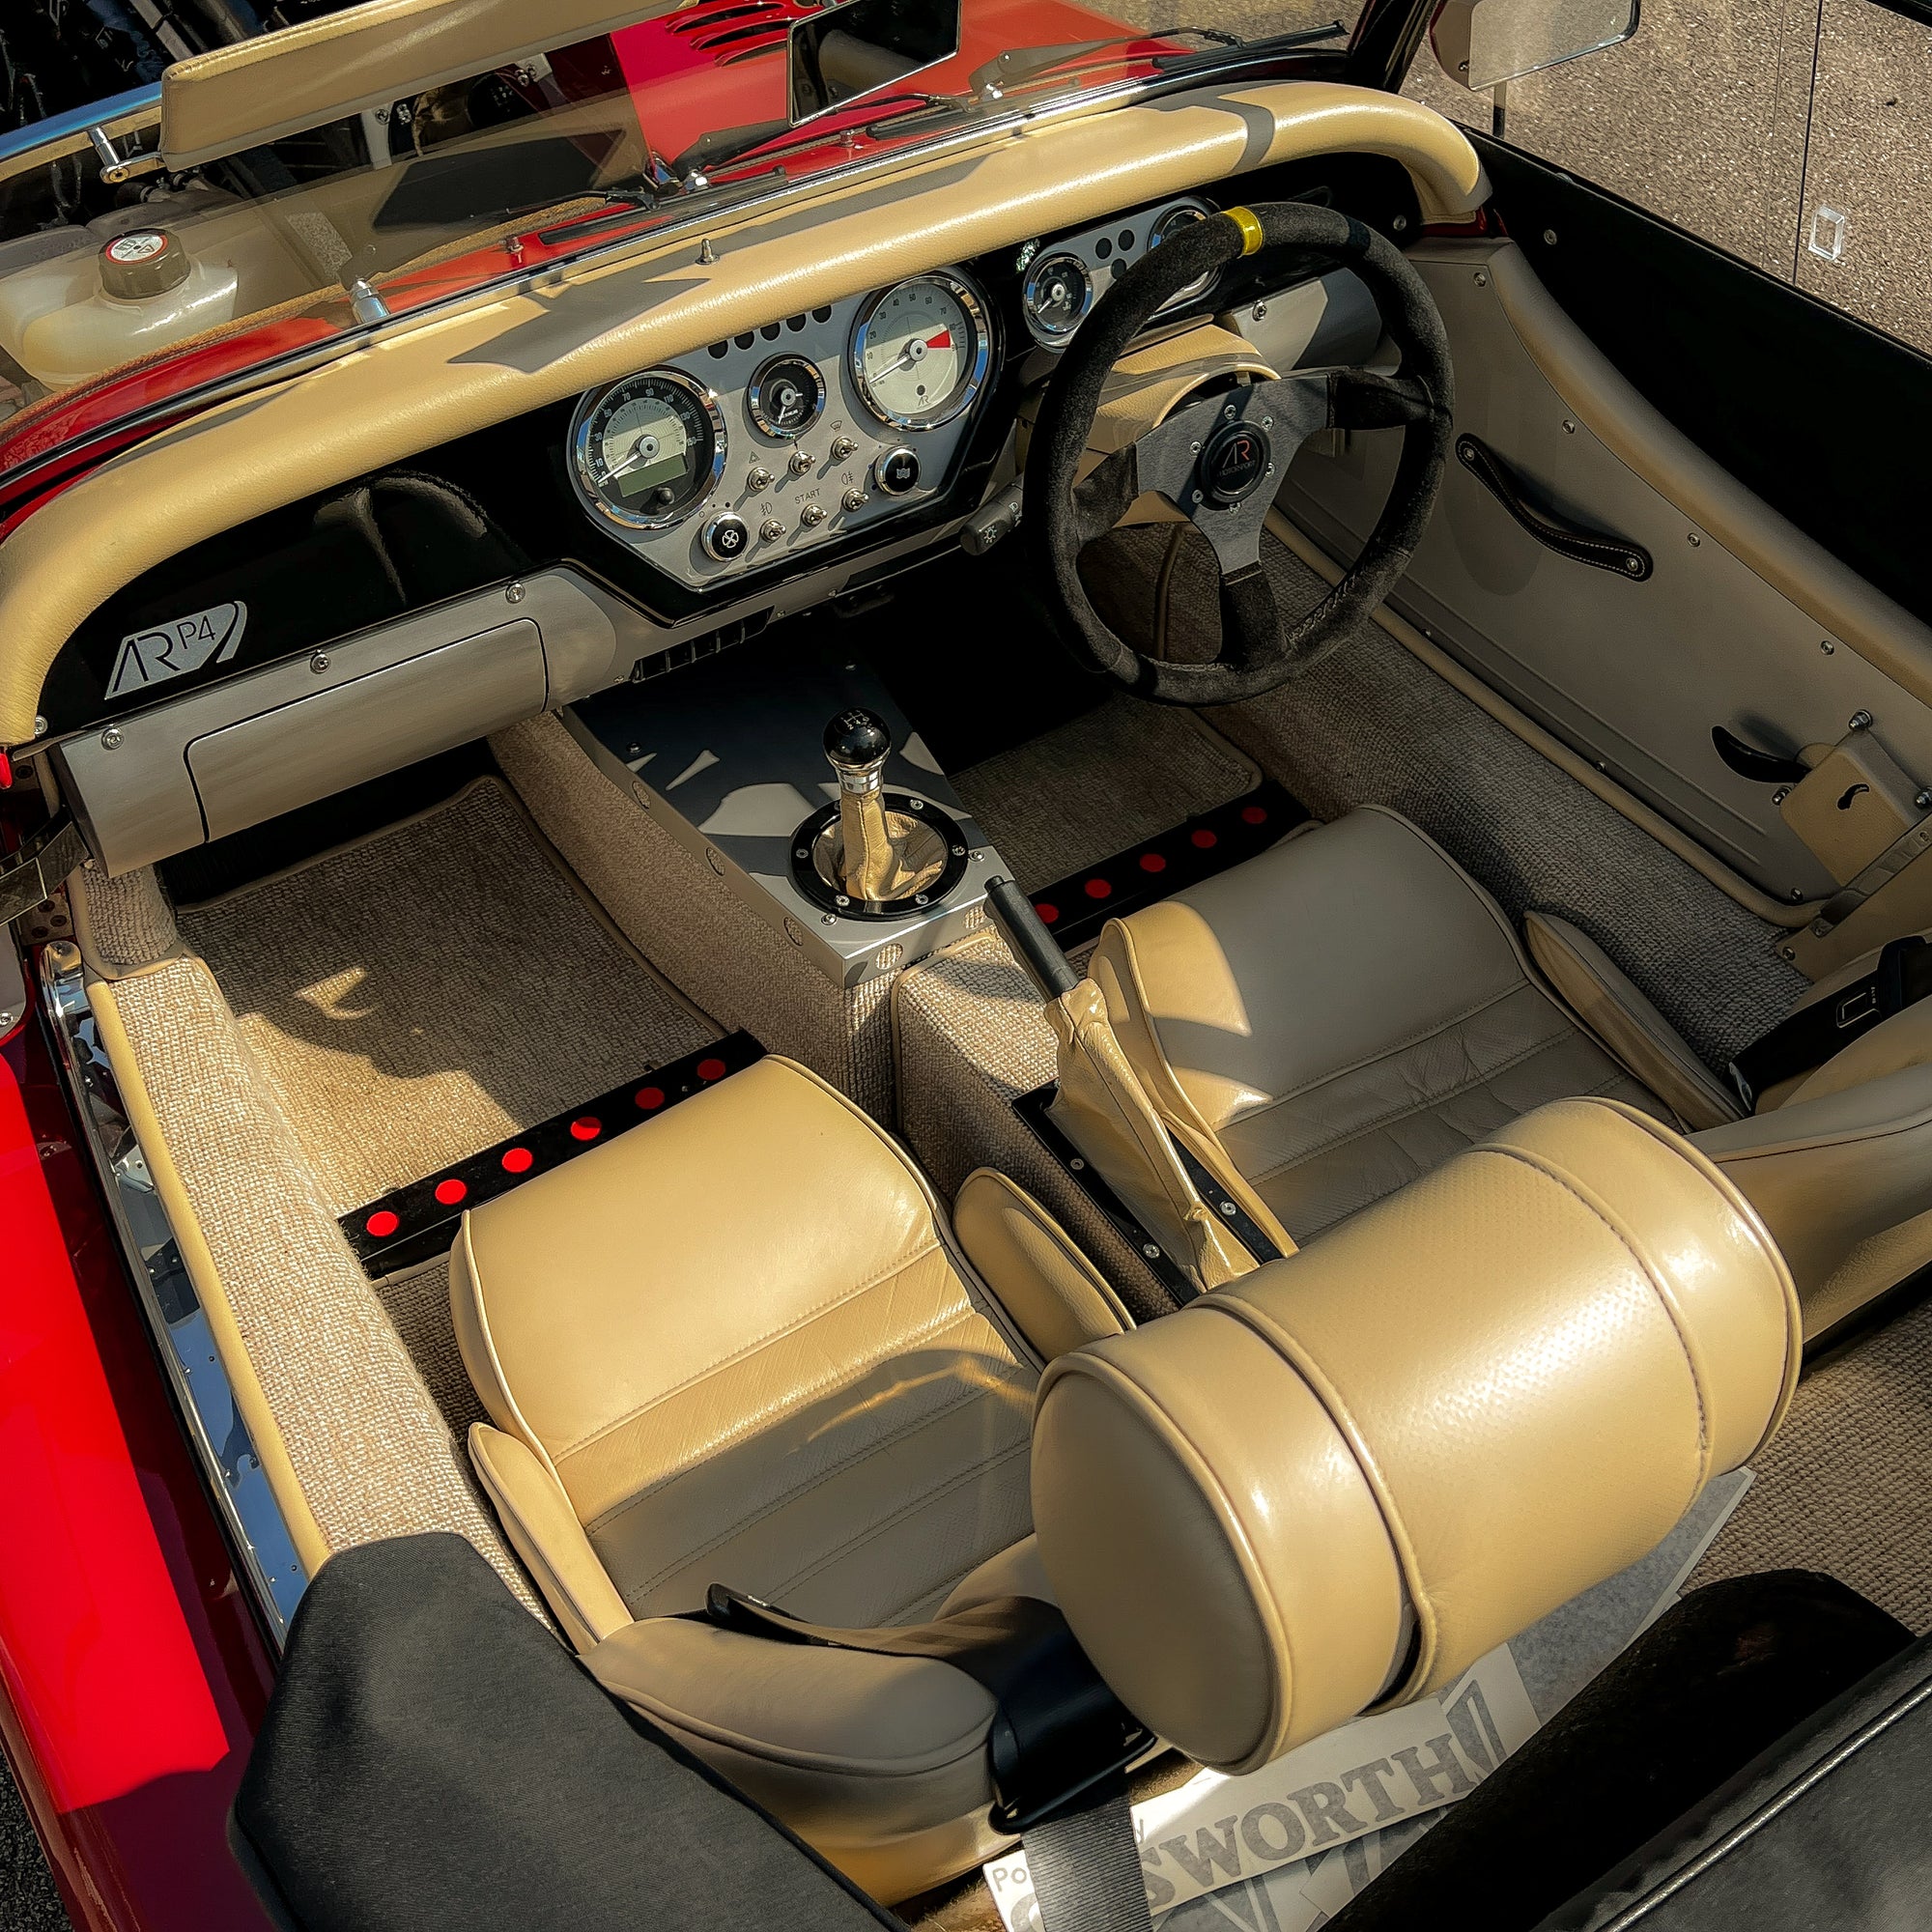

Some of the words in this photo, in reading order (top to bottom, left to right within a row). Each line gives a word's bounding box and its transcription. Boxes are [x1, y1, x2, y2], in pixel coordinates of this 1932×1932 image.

[908, 293, 917, 301] 50
[893, 298, 900, 307] 40
[878, 311, 887, 320] 30
[939, 306, 948, 316] 70
[869, 330, 877, 340] 20
[621, 391, 631, 402] 70
[644, 387, 655, 397] 90
[664, 394, 674, 404] 110
[593, 431, 603, 441] 30
[595, 457, 604, 467] 10
[794, 487, 821, 504] START
[112, 631, 182, 693] AR
[176, 614, 216, 650] P4
